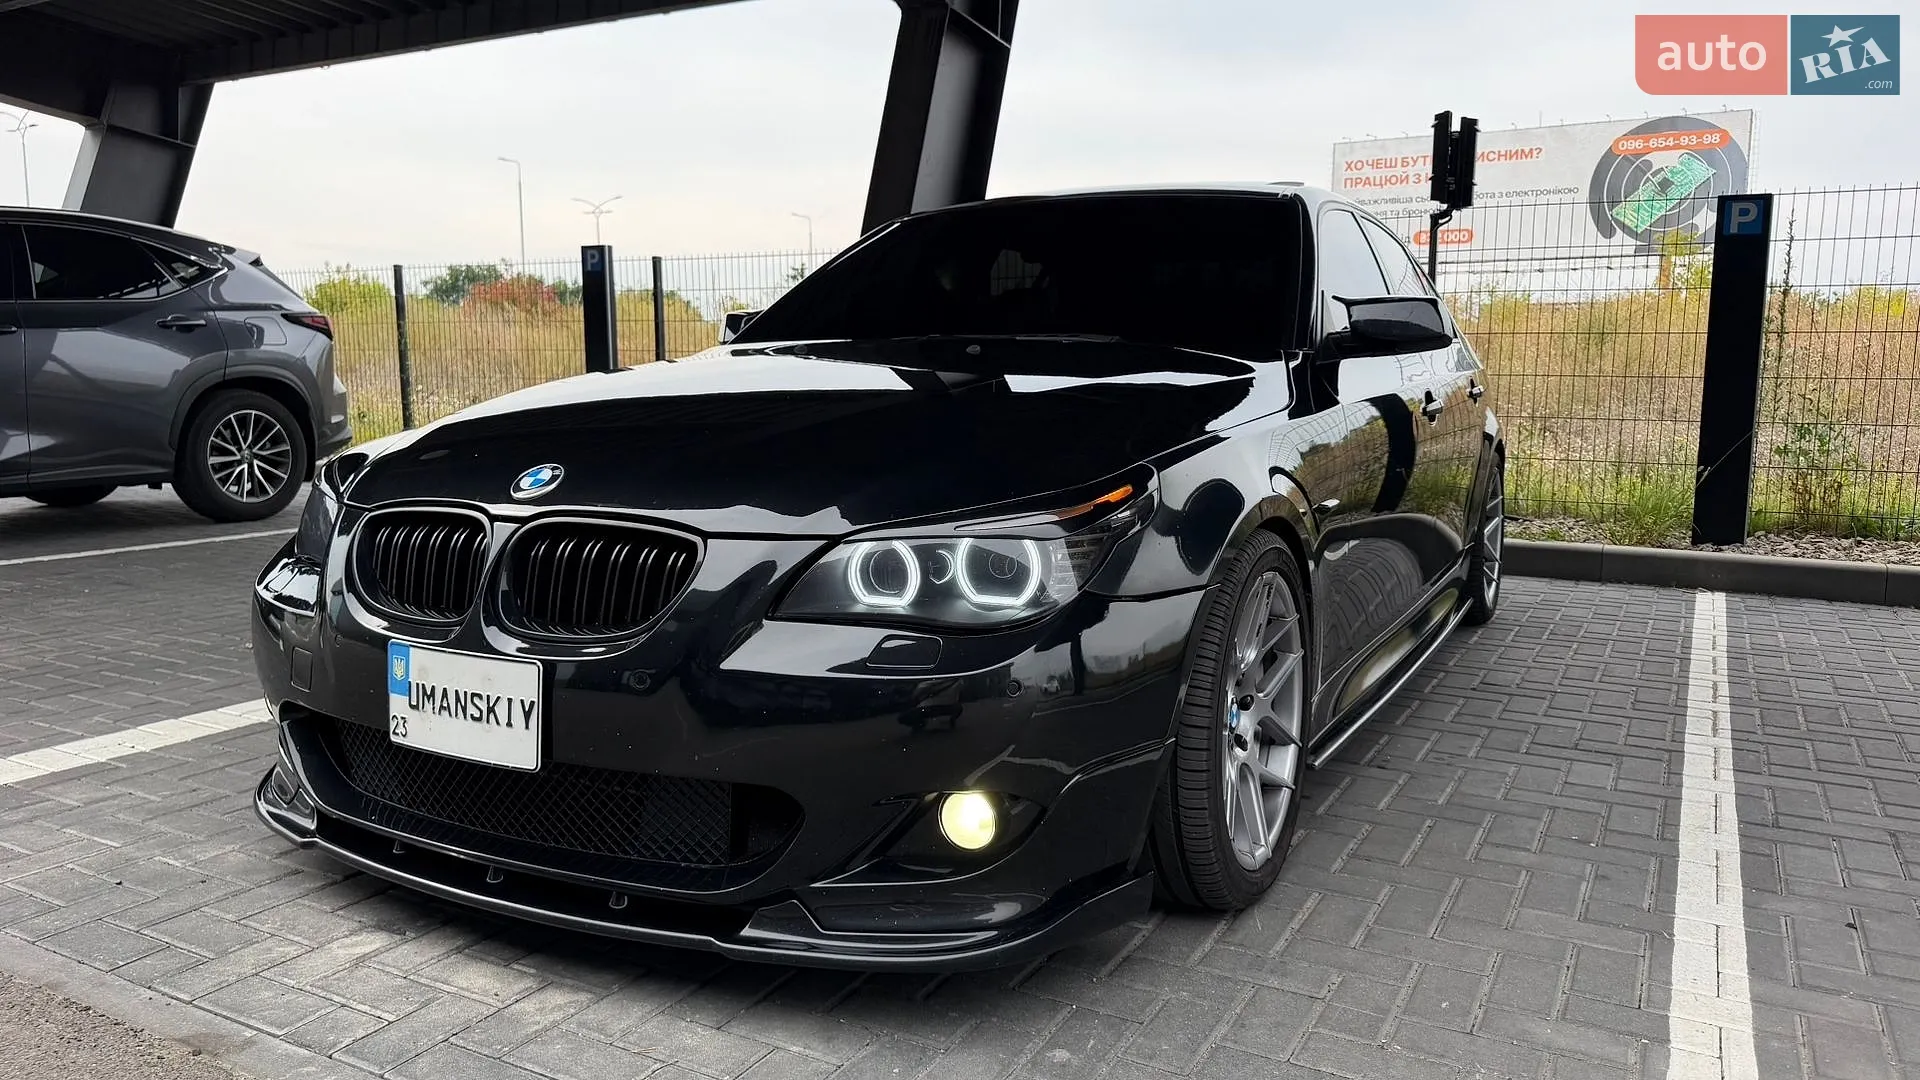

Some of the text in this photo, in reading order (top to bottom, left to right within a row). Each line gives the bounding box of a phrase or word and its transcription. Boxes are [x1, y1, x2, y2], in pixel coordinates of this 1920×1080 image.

[1618, 133, 1721, 151] 096-654-93-98
[1344, 157, 1398, 172] ХОЧЕШ
[1476, 147, 1543, 163] ИСНИМ?
[1344, 171, 1410, 189] ПРАЦЮЙ
[1505, 186, 1579, 200] електронікою
[1730, 202, 1758, 233] P
[587, 249, 600, 271] P
[408, 680, 536, 731] UMANSKIY
[391, 714, 408, 738] 23
